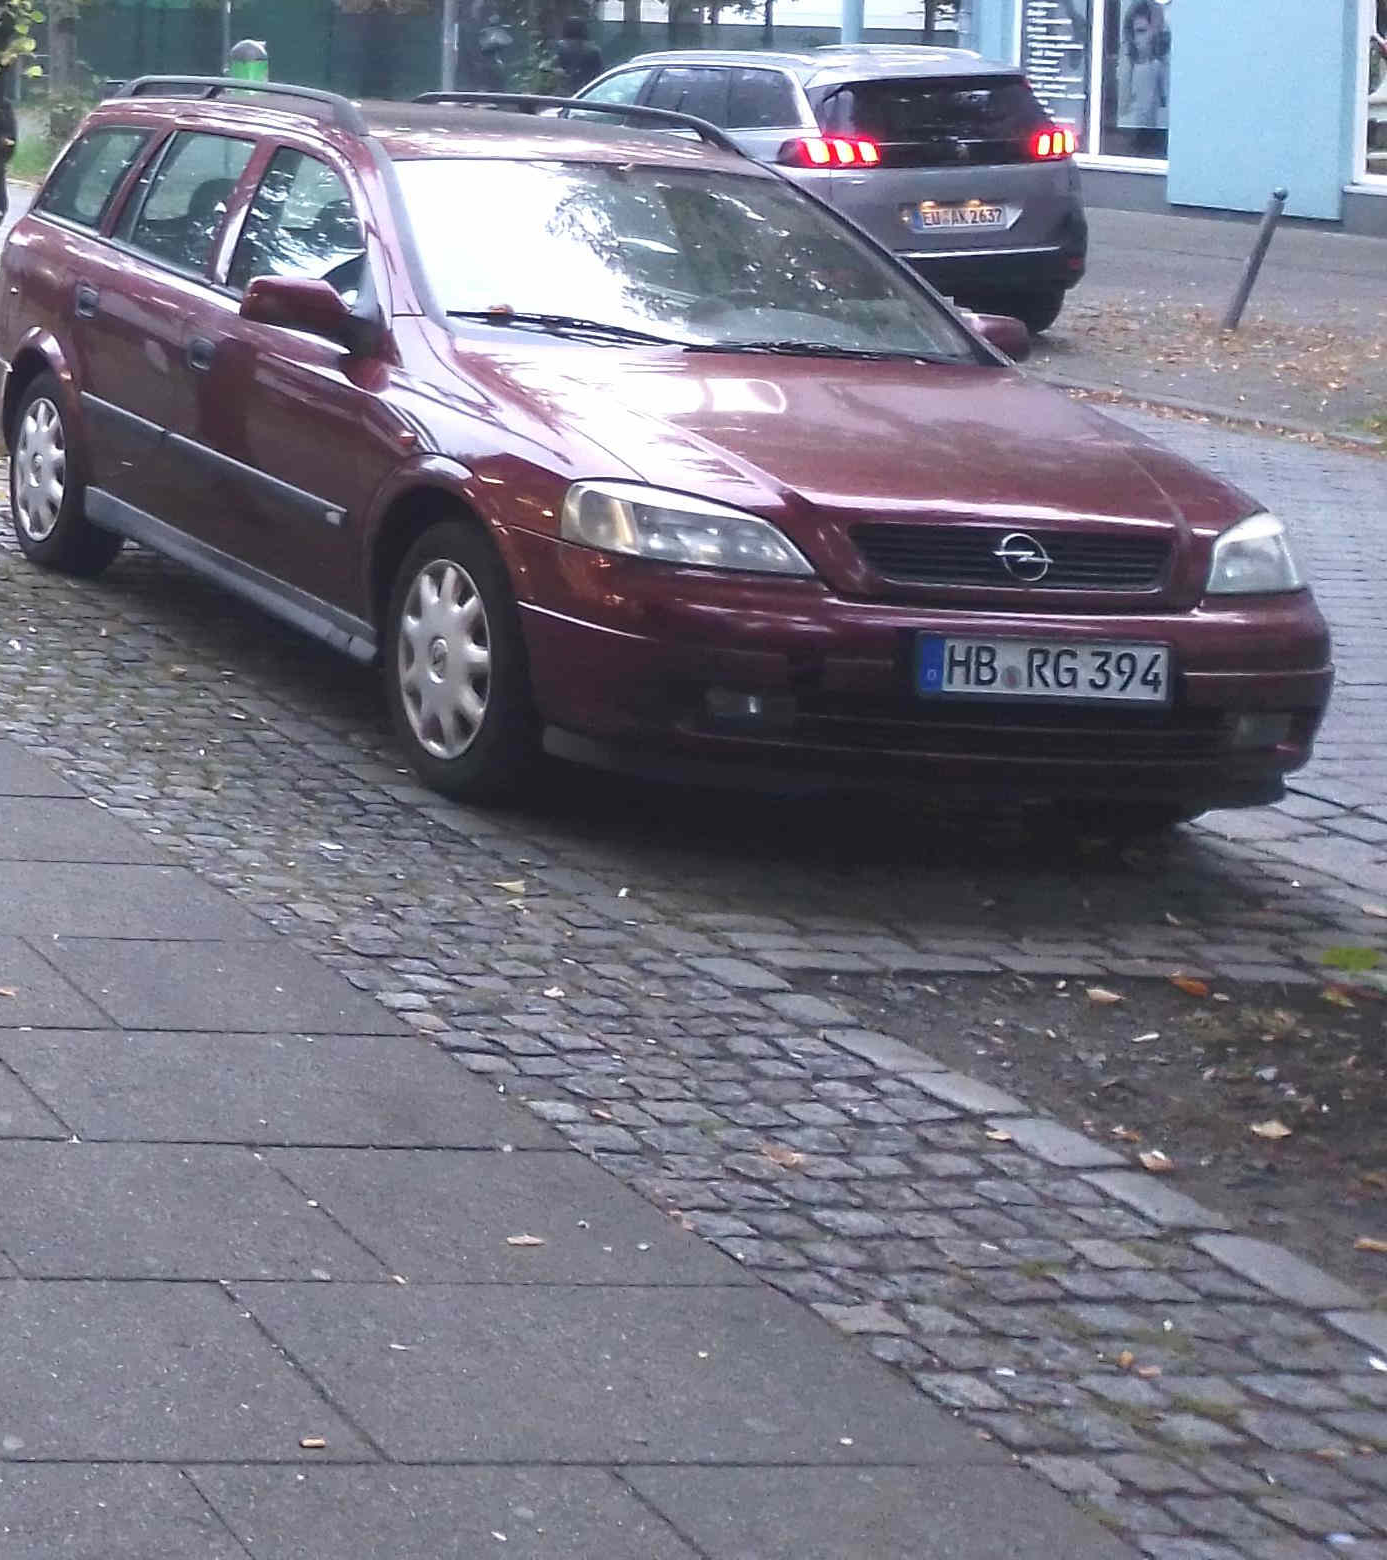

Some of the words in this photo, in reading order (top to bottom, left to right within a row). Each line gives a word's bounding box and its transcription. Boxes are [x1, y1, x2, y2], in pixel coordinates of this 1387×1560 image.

[970, 208, 1003, 224] 2637
[946, 644, 998, 687] HB
[1026, 648, 1078, 690] RG
[1089, 650, 1163, 694] 394
